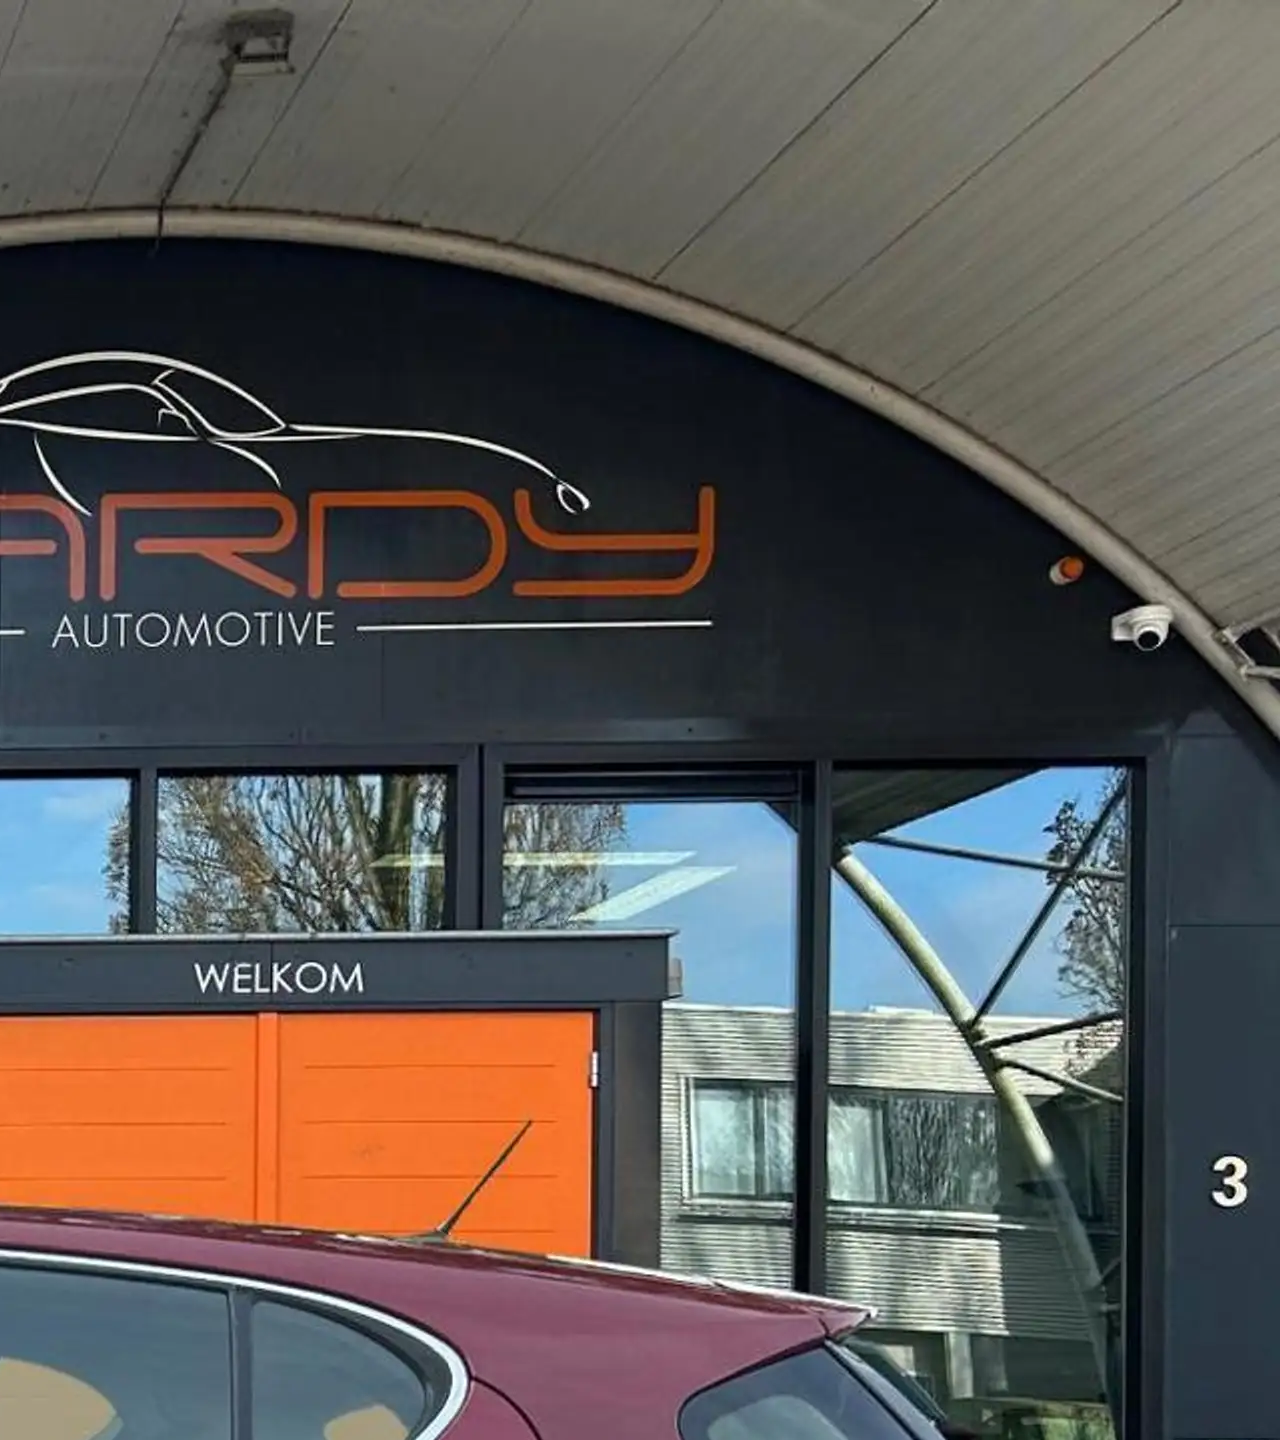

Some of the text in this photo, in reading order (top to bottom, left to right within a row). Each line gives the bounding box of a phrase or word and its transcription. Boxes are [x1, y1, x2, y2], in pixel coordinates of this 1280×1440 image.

[51, 610, 335, 649] AUTOMOTIVE
[194, 961, 364, 994] WELKOM
[1211, 1155, 1249, 1208] 3
